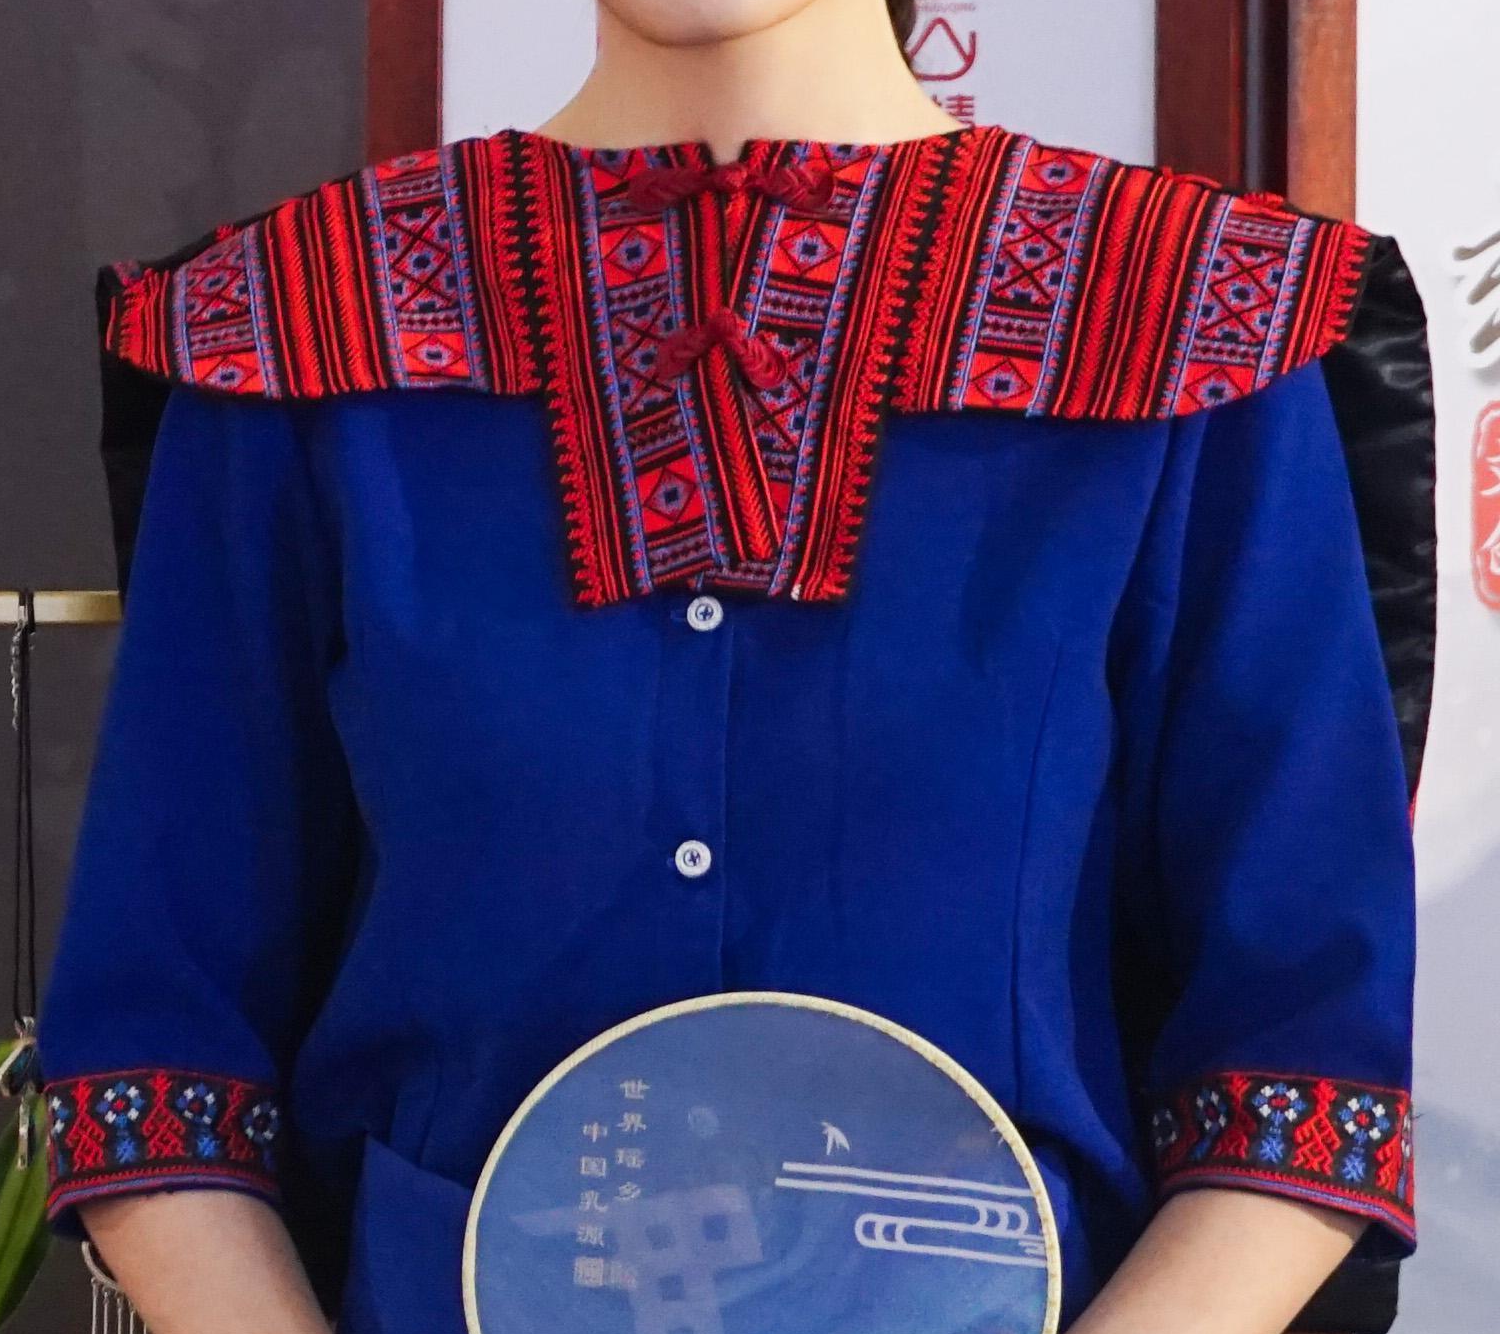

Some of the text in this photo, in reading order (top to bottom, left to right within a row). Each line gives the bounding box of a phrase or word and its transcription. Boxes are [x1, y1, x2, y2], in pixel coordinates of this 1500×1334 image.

[576, 1121, 610, 1248] 中国乳源
[612, 1077, 651, 1201] 世界瑶乡
